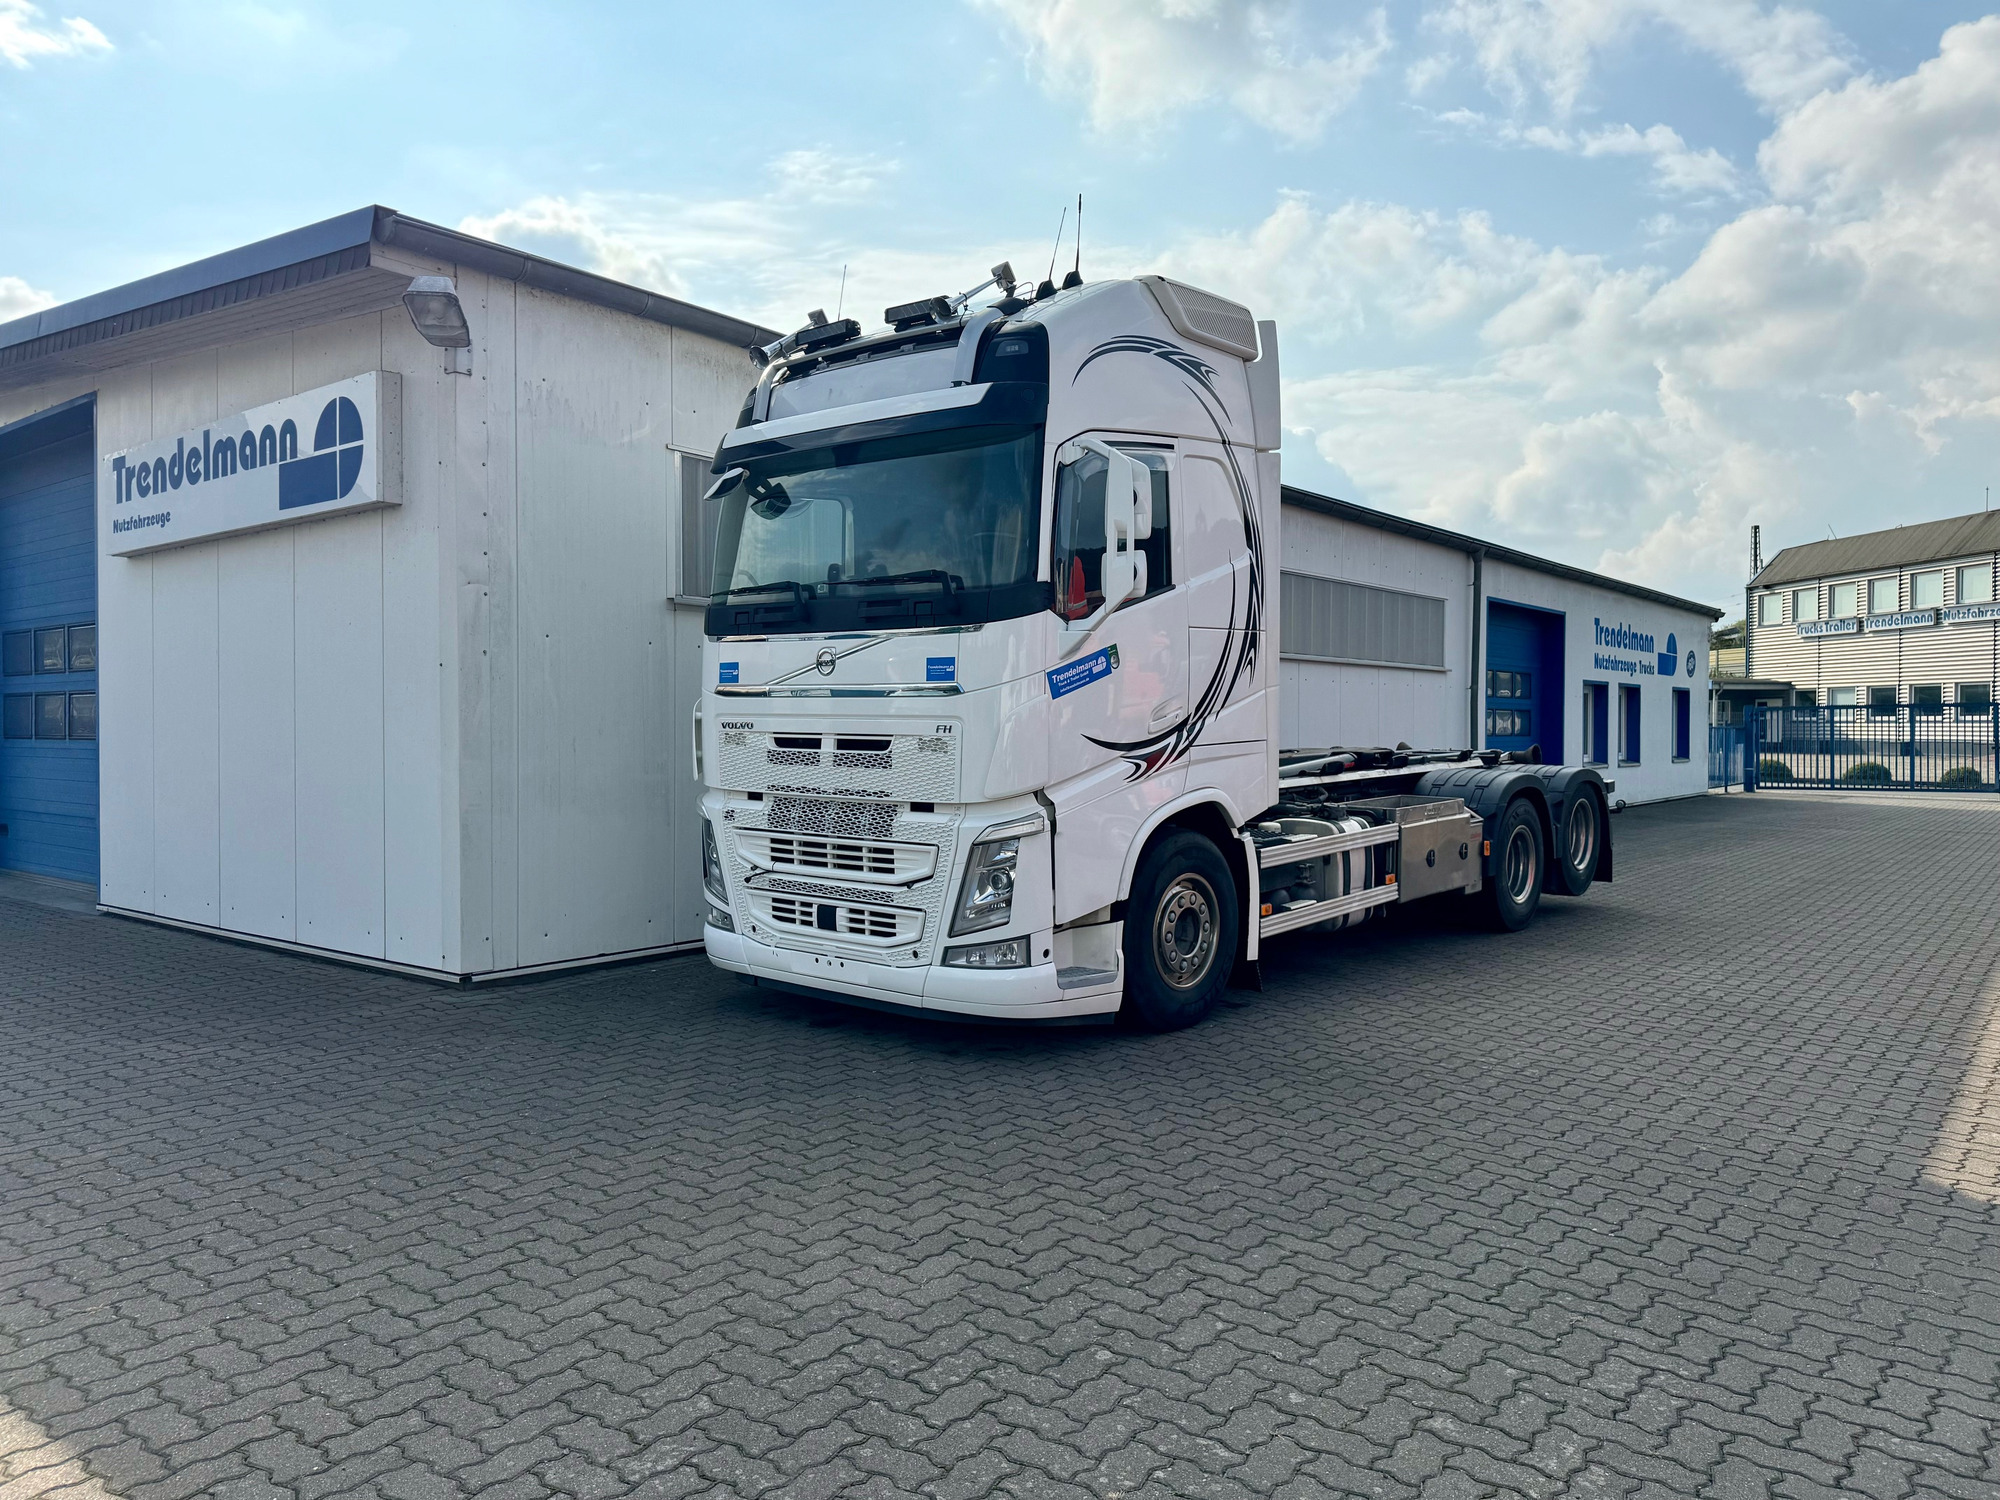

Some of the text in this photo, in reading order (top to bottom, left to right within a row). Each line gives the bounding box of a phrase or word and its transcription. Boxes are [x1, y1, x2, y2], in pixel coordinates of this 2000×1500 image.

[112, 418, 298, 504] Trendelmann
[113, 511, 171, 534] Nutzfahrzeuge
[1797, 619, 1855, 635] Trucks Trailer
[1864, 613, 1933, 629] Trendelmann
[1594, 617, 1654, 653] Trendelmann
[1052, 660, 1097, 683] Trendelmann
[1594, 652, 1655, 677] Nutzfahrzeuge Trucks
[721, 721, 754, 730] VOLVO
[935, 724, 952, 734] FH
